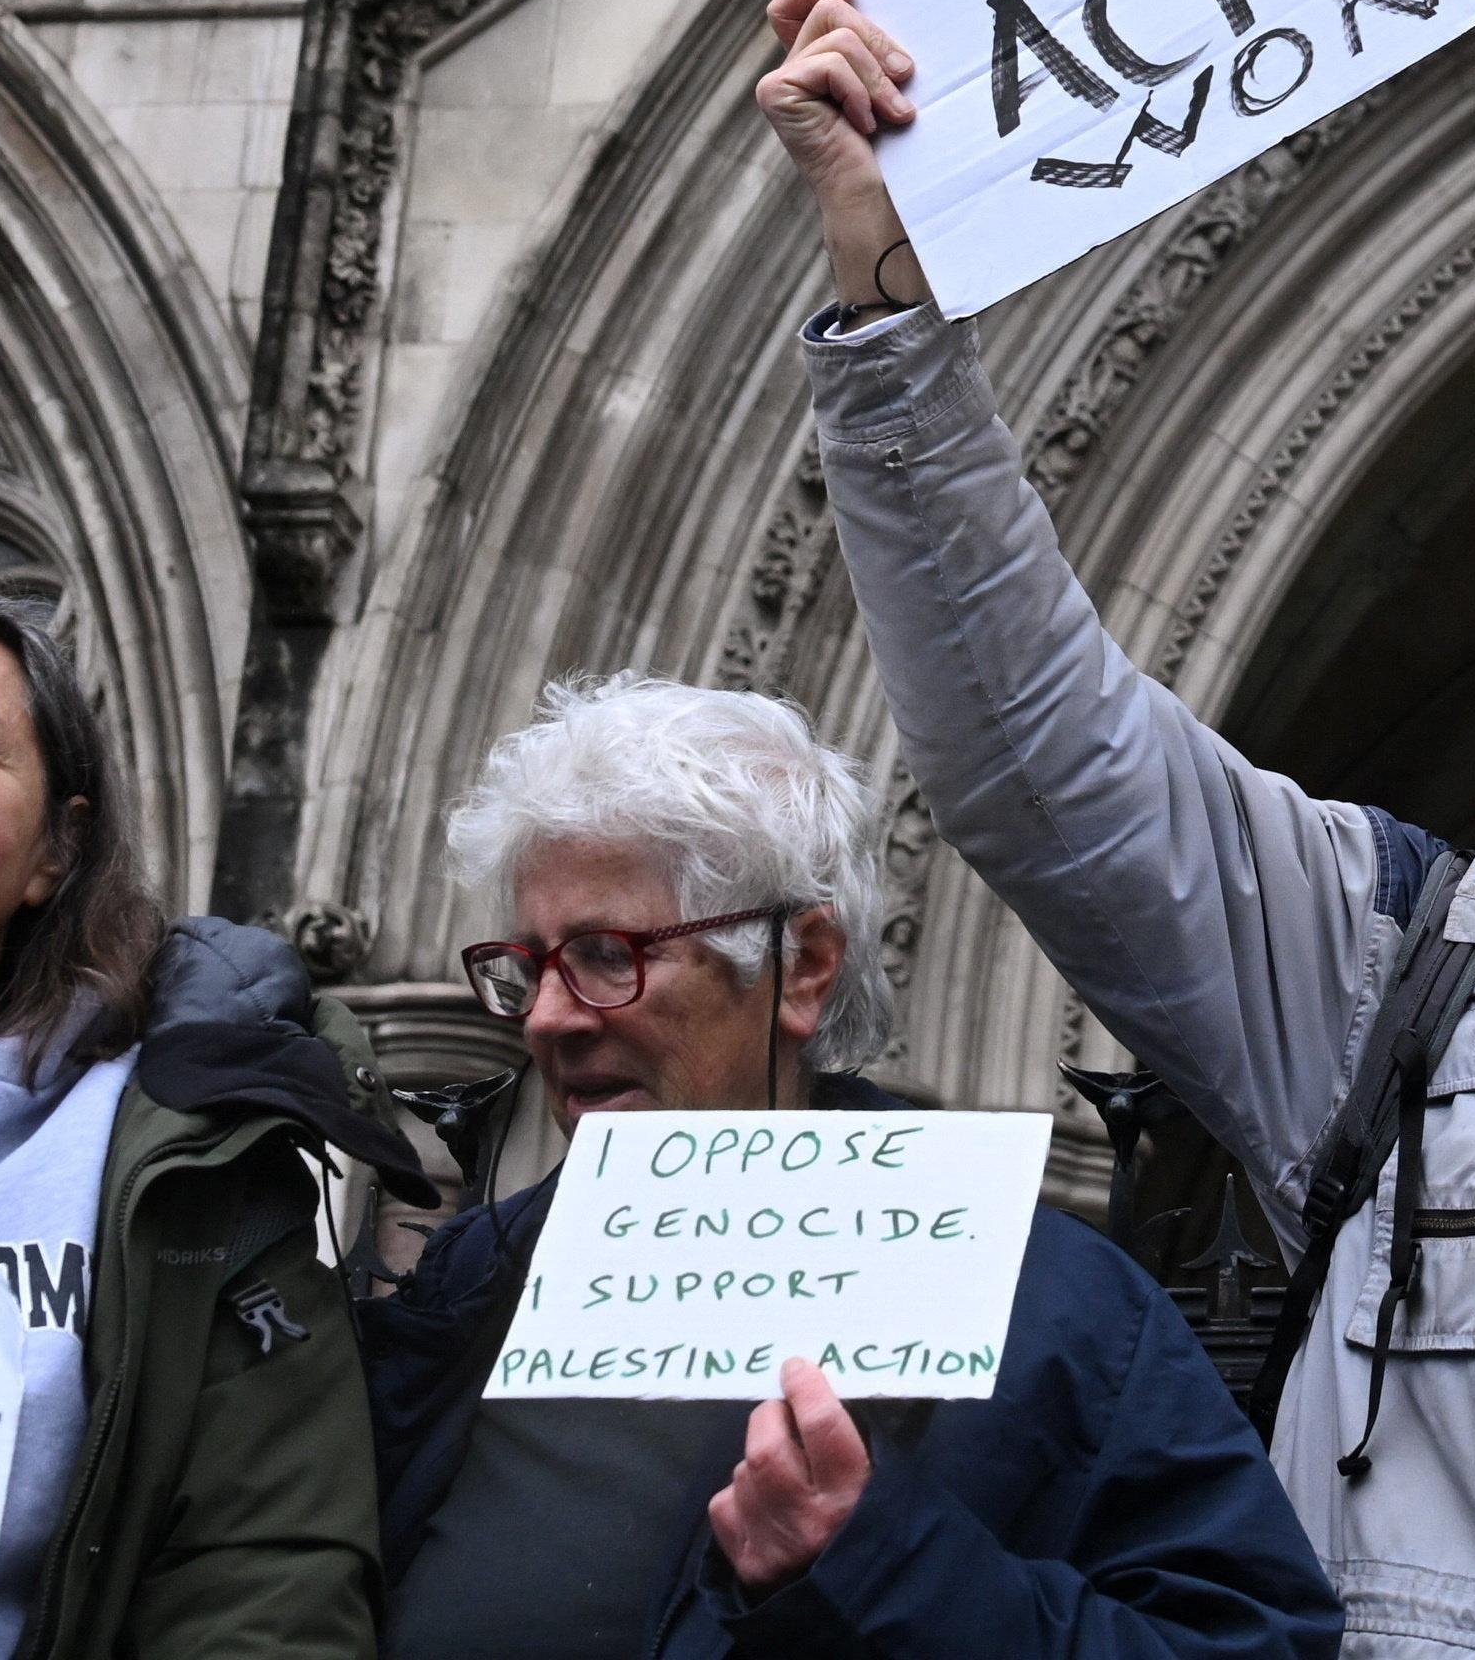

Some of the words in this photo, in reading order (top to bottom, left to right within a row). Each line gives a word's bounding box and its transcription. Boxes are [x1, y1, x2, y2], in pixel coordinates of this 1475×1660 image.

[595, 1127, 614, 1178] I
[650, 1126, 924, 1178] OPPOSE
[532, 1274, 543, 1311] I
[582, 1269, 860, 1311] SUPPORT
[501, 1342, 775, 1387] PALESTINE
